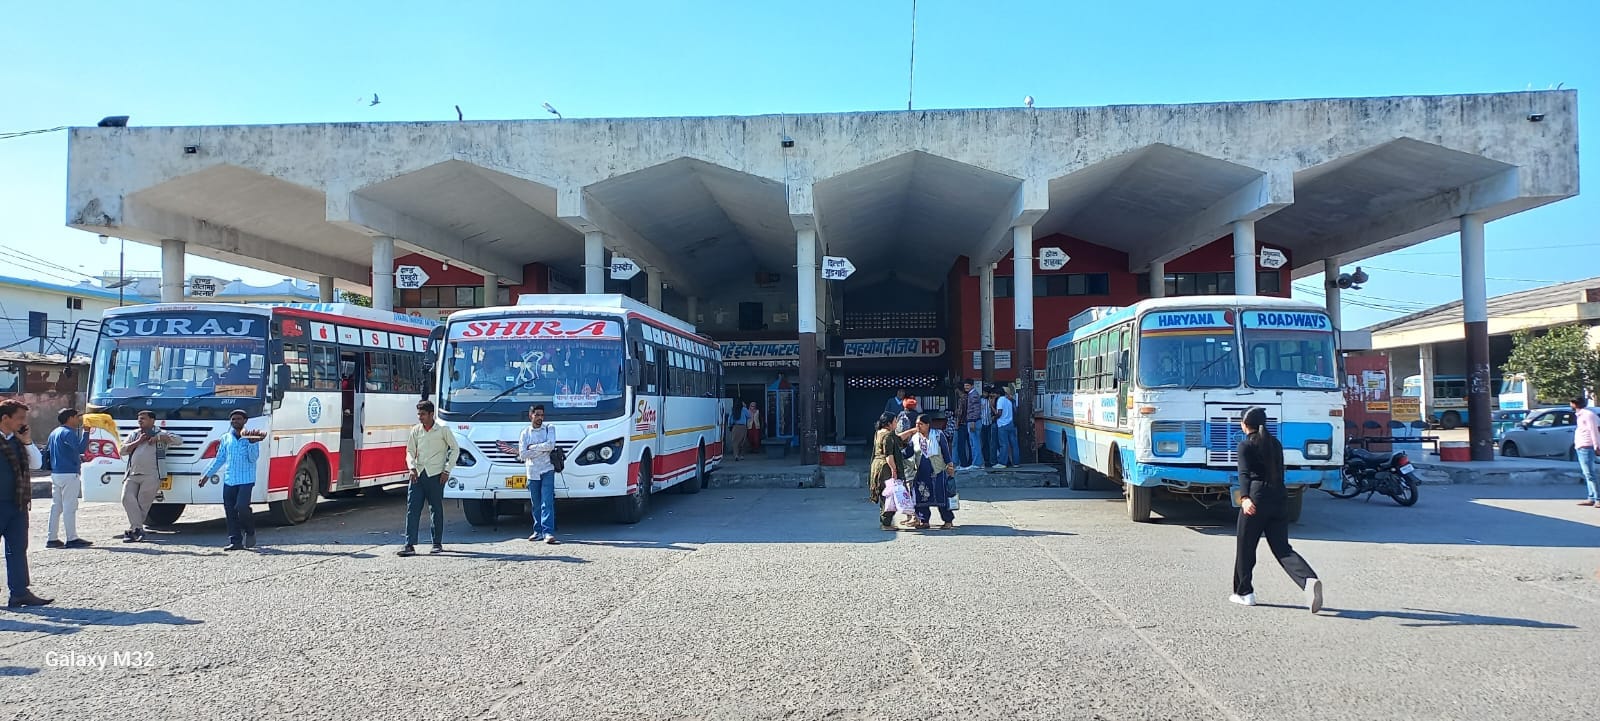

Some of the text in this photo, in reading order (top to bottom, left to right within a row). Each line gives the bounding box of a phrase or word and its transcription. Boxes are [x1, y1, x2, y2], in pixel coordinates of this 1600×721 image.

[1158, 313, 1215, 326] HARYANA
[1257, 313, 1326, 328] ROADWAYS
[108, 319, 255, 337] SURAJ
[463, 321, 606, 337] SHIRA
